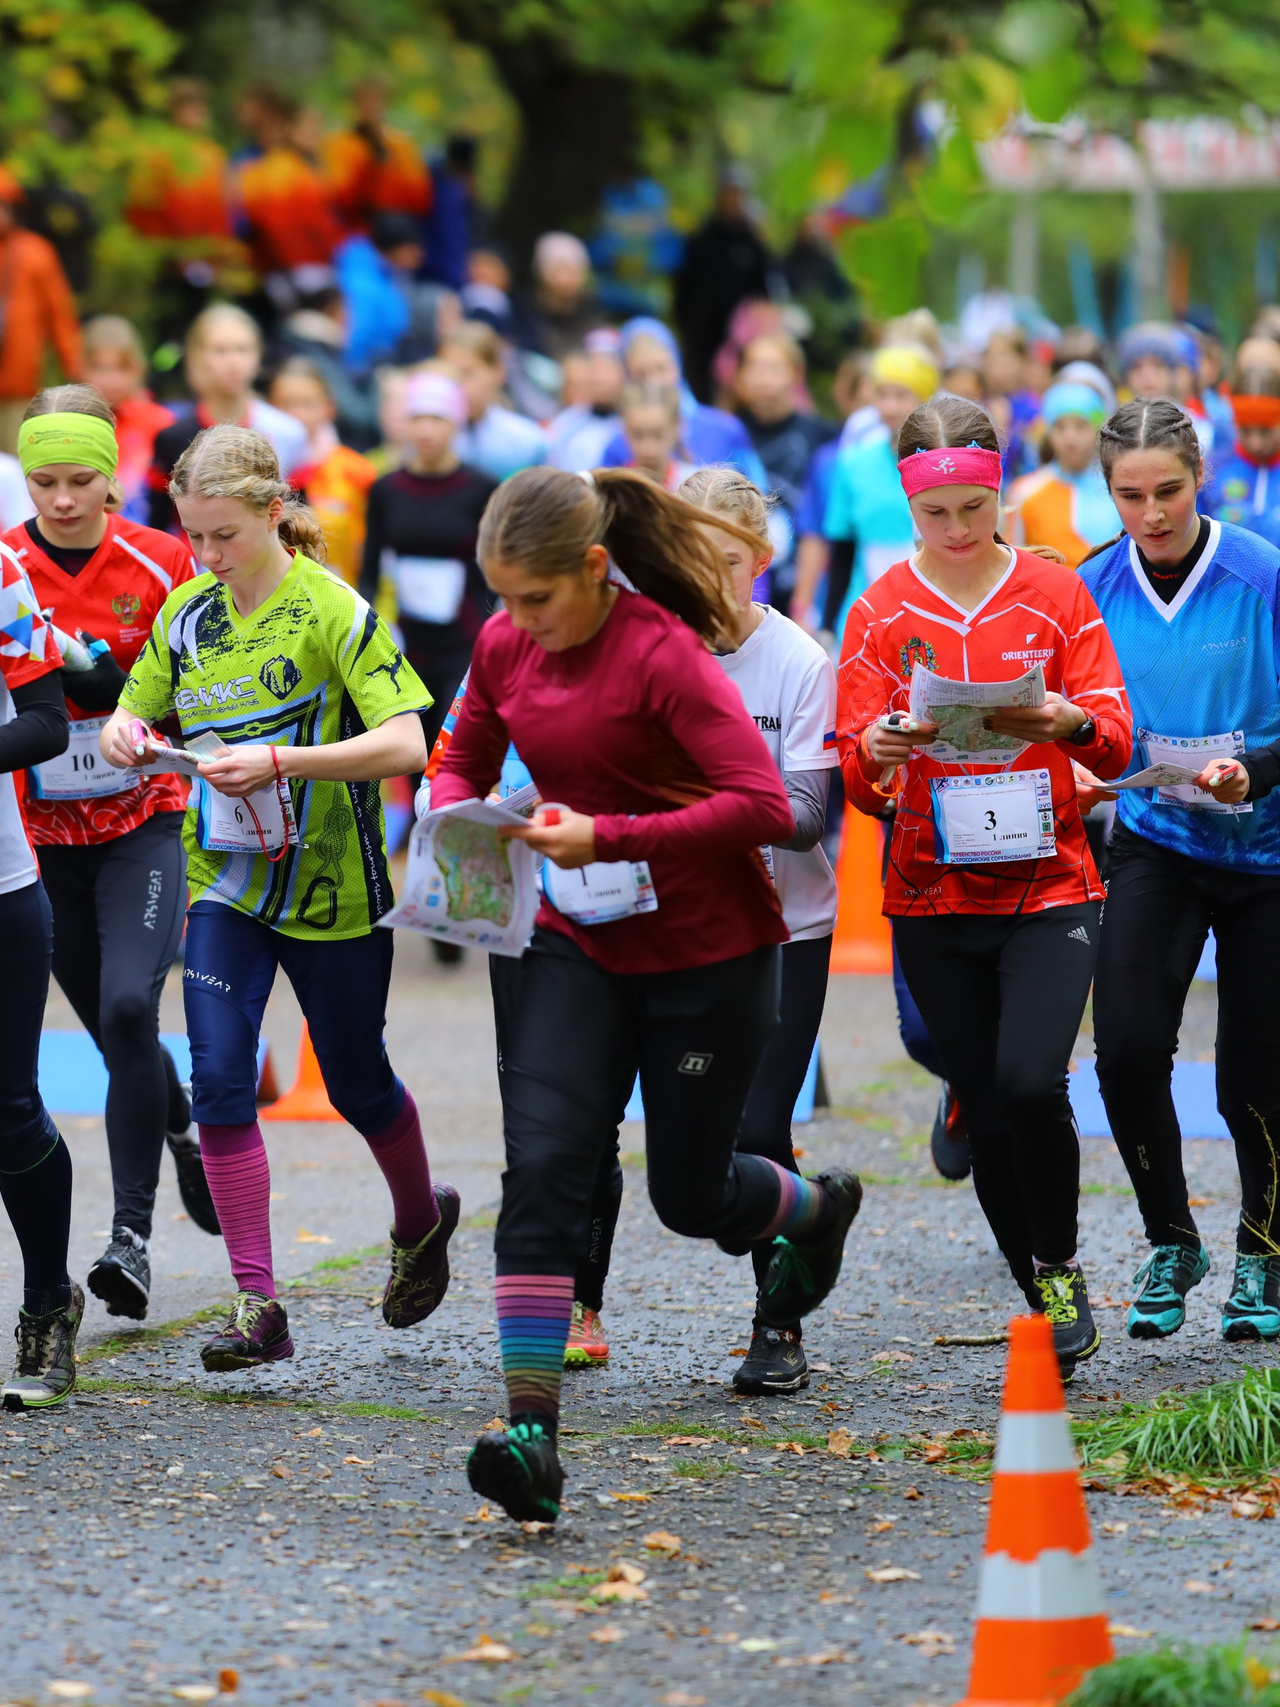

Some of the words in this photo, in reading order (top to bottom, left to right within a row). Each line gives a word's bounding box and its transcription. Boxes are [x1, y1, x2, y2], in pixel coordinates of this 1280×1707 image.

[71, 752, 96, 772] 10
[91, 770, 116, 780] линия
[234, 805, 244, 825] 6
[984, 810, 998, 831] 3
[1000, 832, 1028, 841] линия
[363, 832, 378, 881] tourism
[990, 852, 1032, 861] СОРЕВНОВАНИЯ
[374, 882, 383, 916] sports
[1067, 932, 1091, 946] adidas
